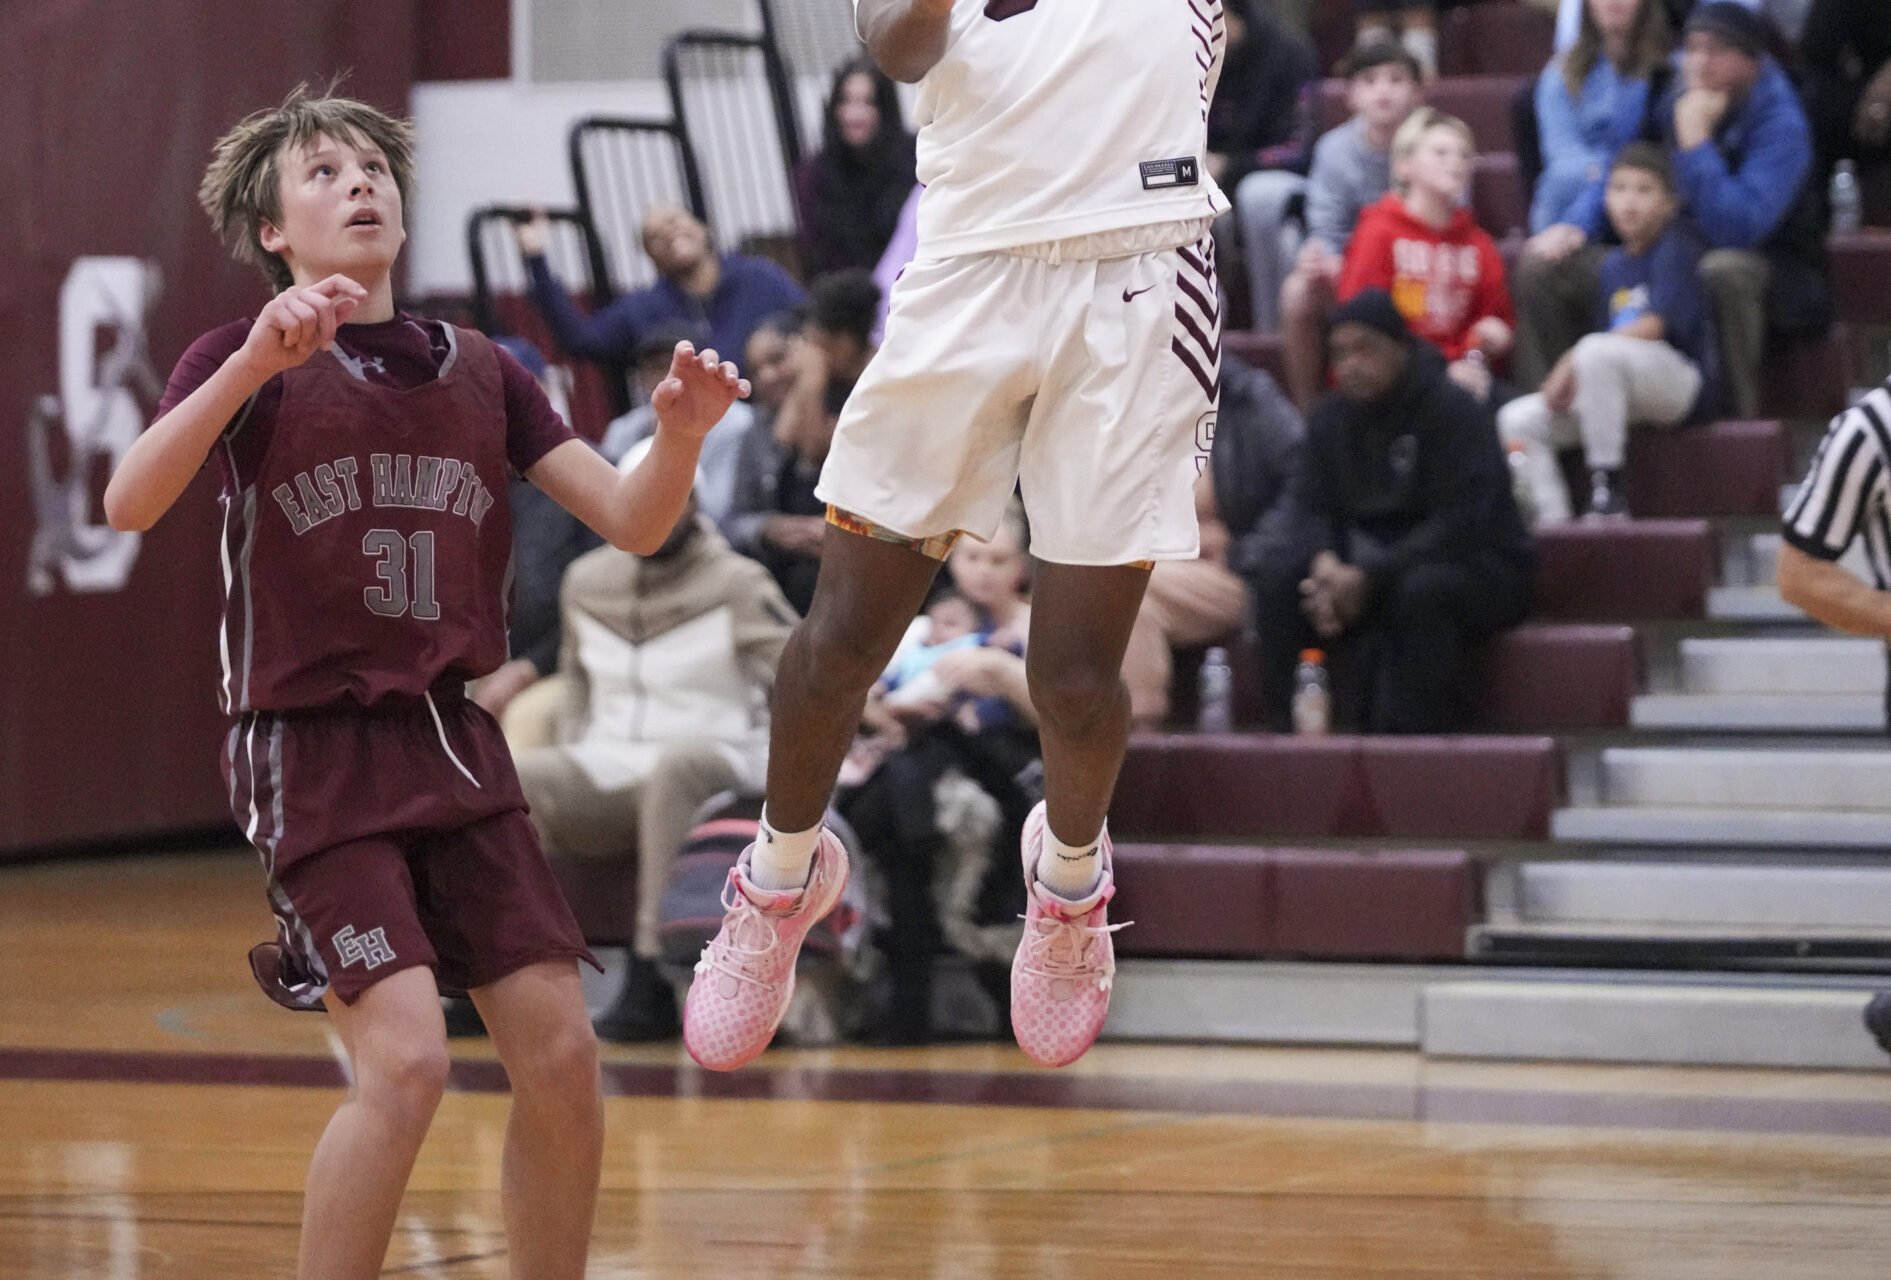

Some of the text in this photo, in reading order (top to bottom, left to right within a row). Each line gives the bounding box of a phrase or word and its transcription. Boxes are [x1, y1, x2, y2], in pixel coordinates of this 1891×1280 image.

[1182, 165, 1192, 178] M
[272, 456, 362, 536] EAST
[362, 528, 441, 620] 31
[332, 924, 397, 970] EH
